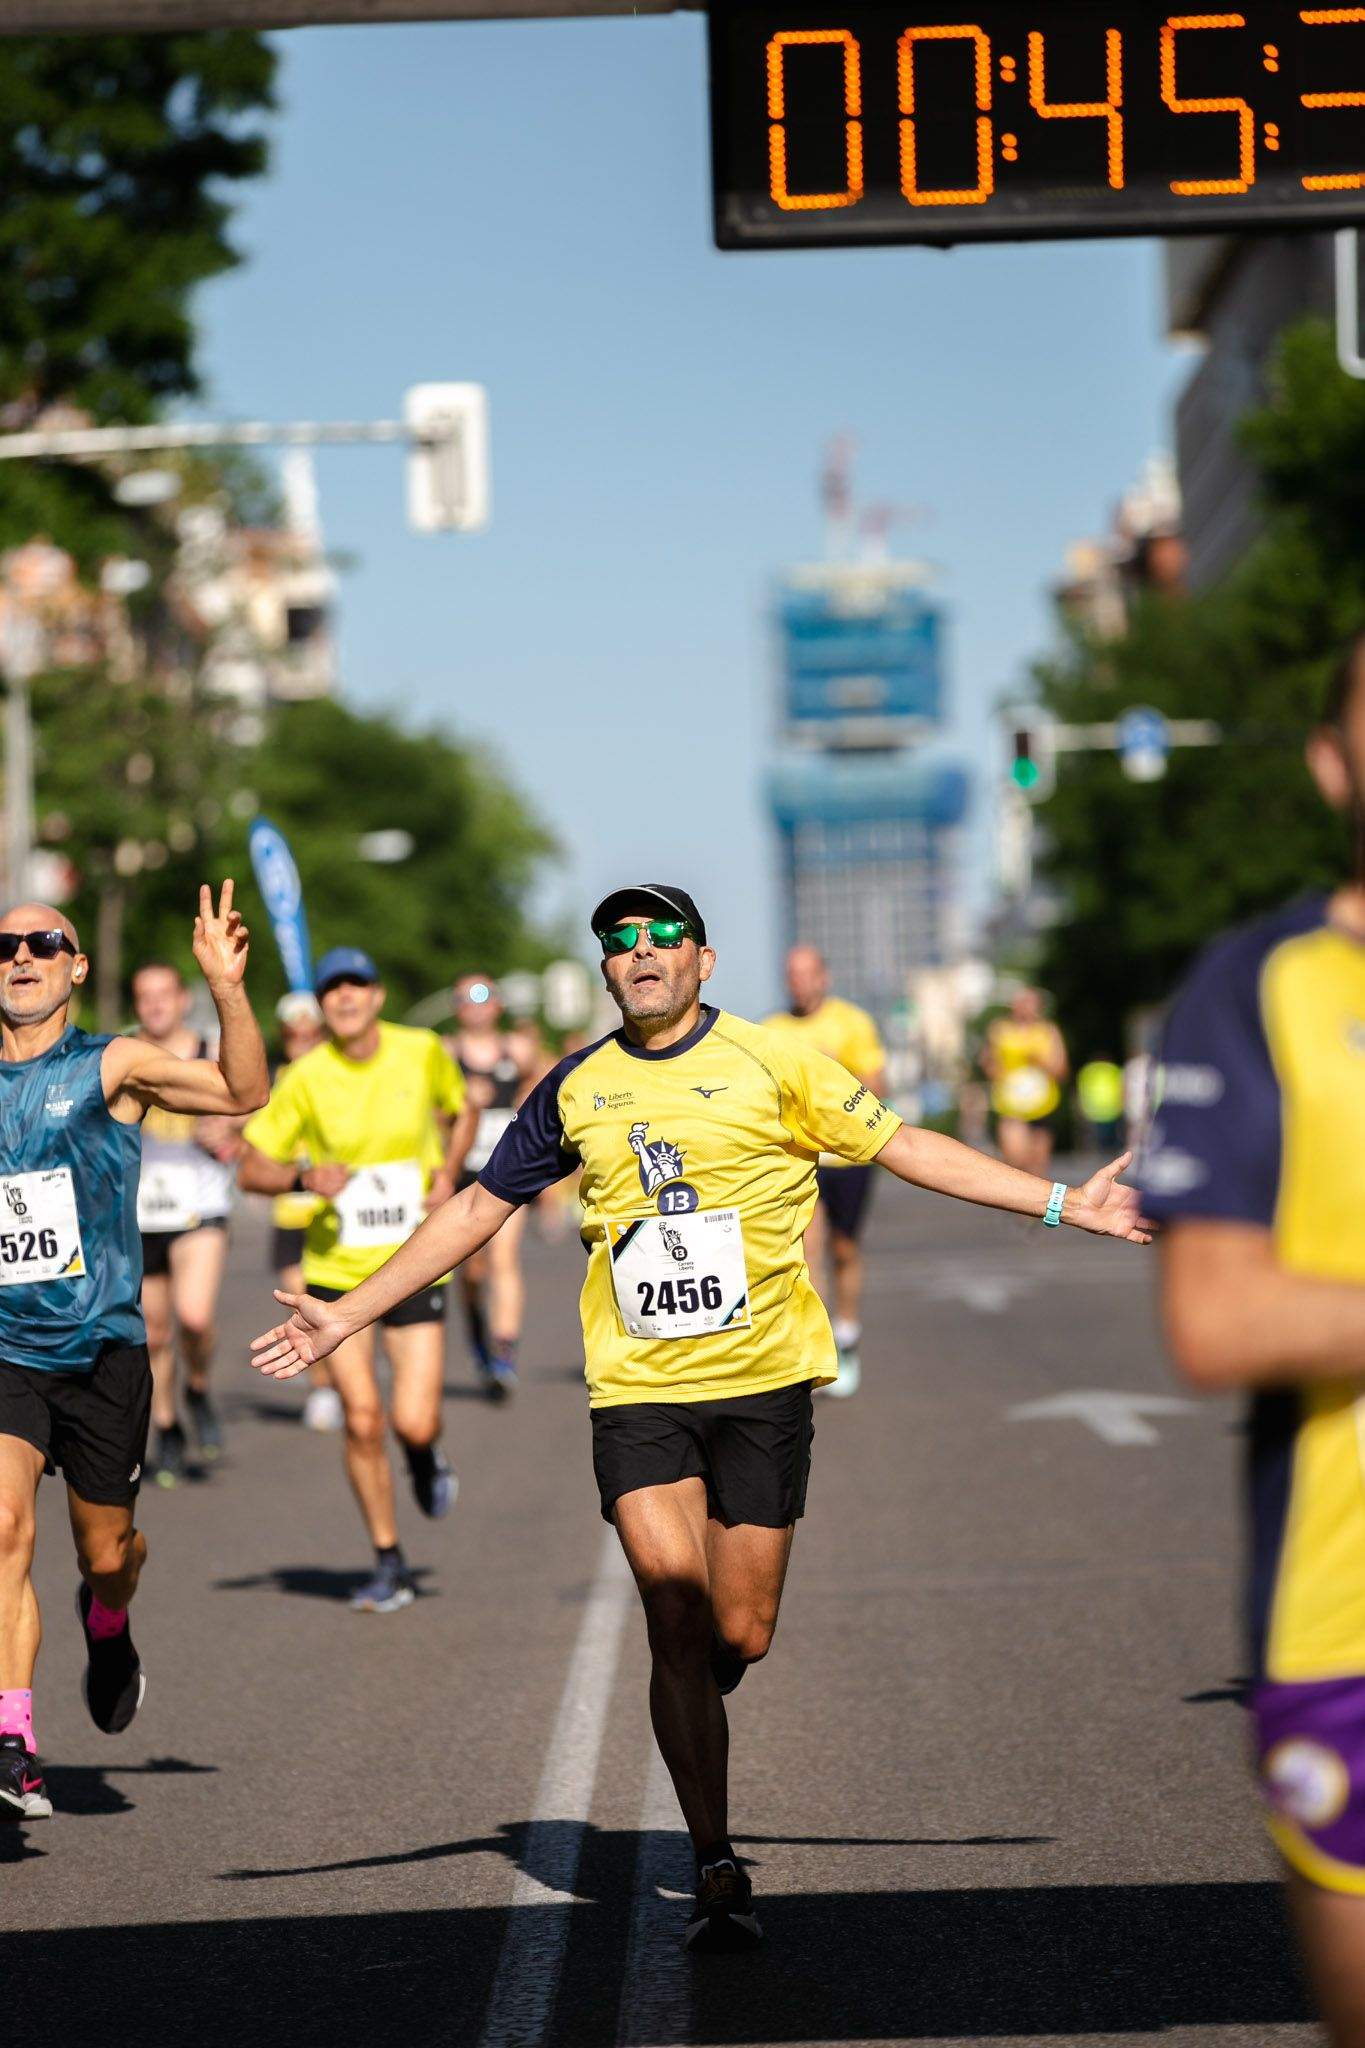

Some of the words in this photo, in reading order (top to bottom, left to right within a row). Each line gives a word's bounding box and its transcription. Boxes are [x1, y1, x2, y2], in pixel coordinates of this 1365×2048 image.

[665, 1191, 690, 1212] 13
[0, 1228, 58, 1264] 526
[674, 1248, 685, 1258] 13
[637, 1275, 723, 1316] 2456
